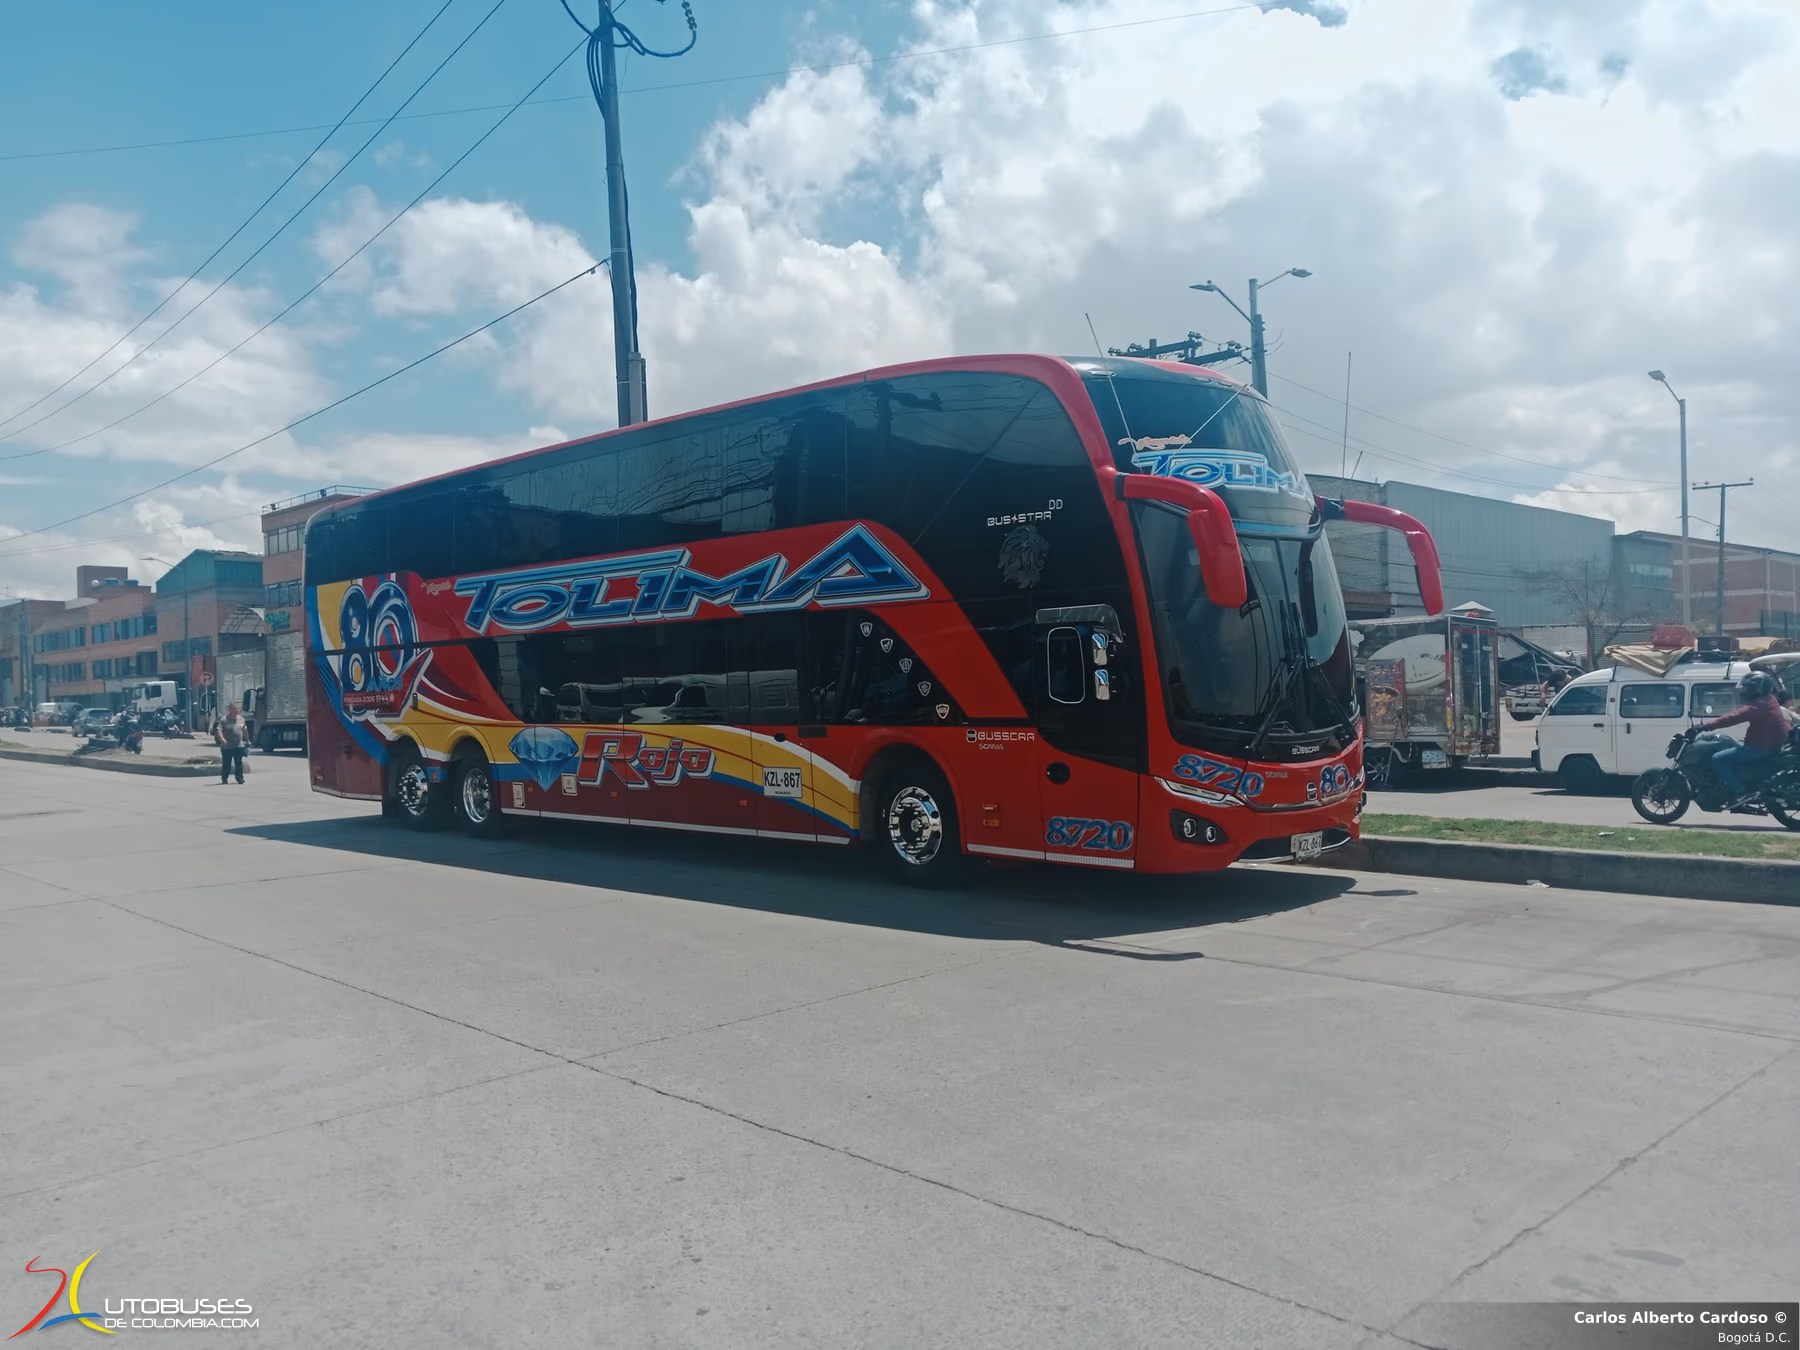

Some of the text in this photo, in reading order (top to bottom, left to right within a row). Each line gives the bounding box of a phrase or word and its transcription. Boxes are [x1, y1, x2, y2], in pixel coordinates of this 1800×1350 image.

[1048, 499, 1063, 510] DD
[454, 523, 930, 636] TOLIMA
[339, 580, 419, 718] 80
[978, 731, 1035, 742] BUSSCAR
[1292, 746, 1320, 755] BUSSCAR
[1172, 755, 1265, 797] 8720
[1045, 816, 1134, 852] 8720
